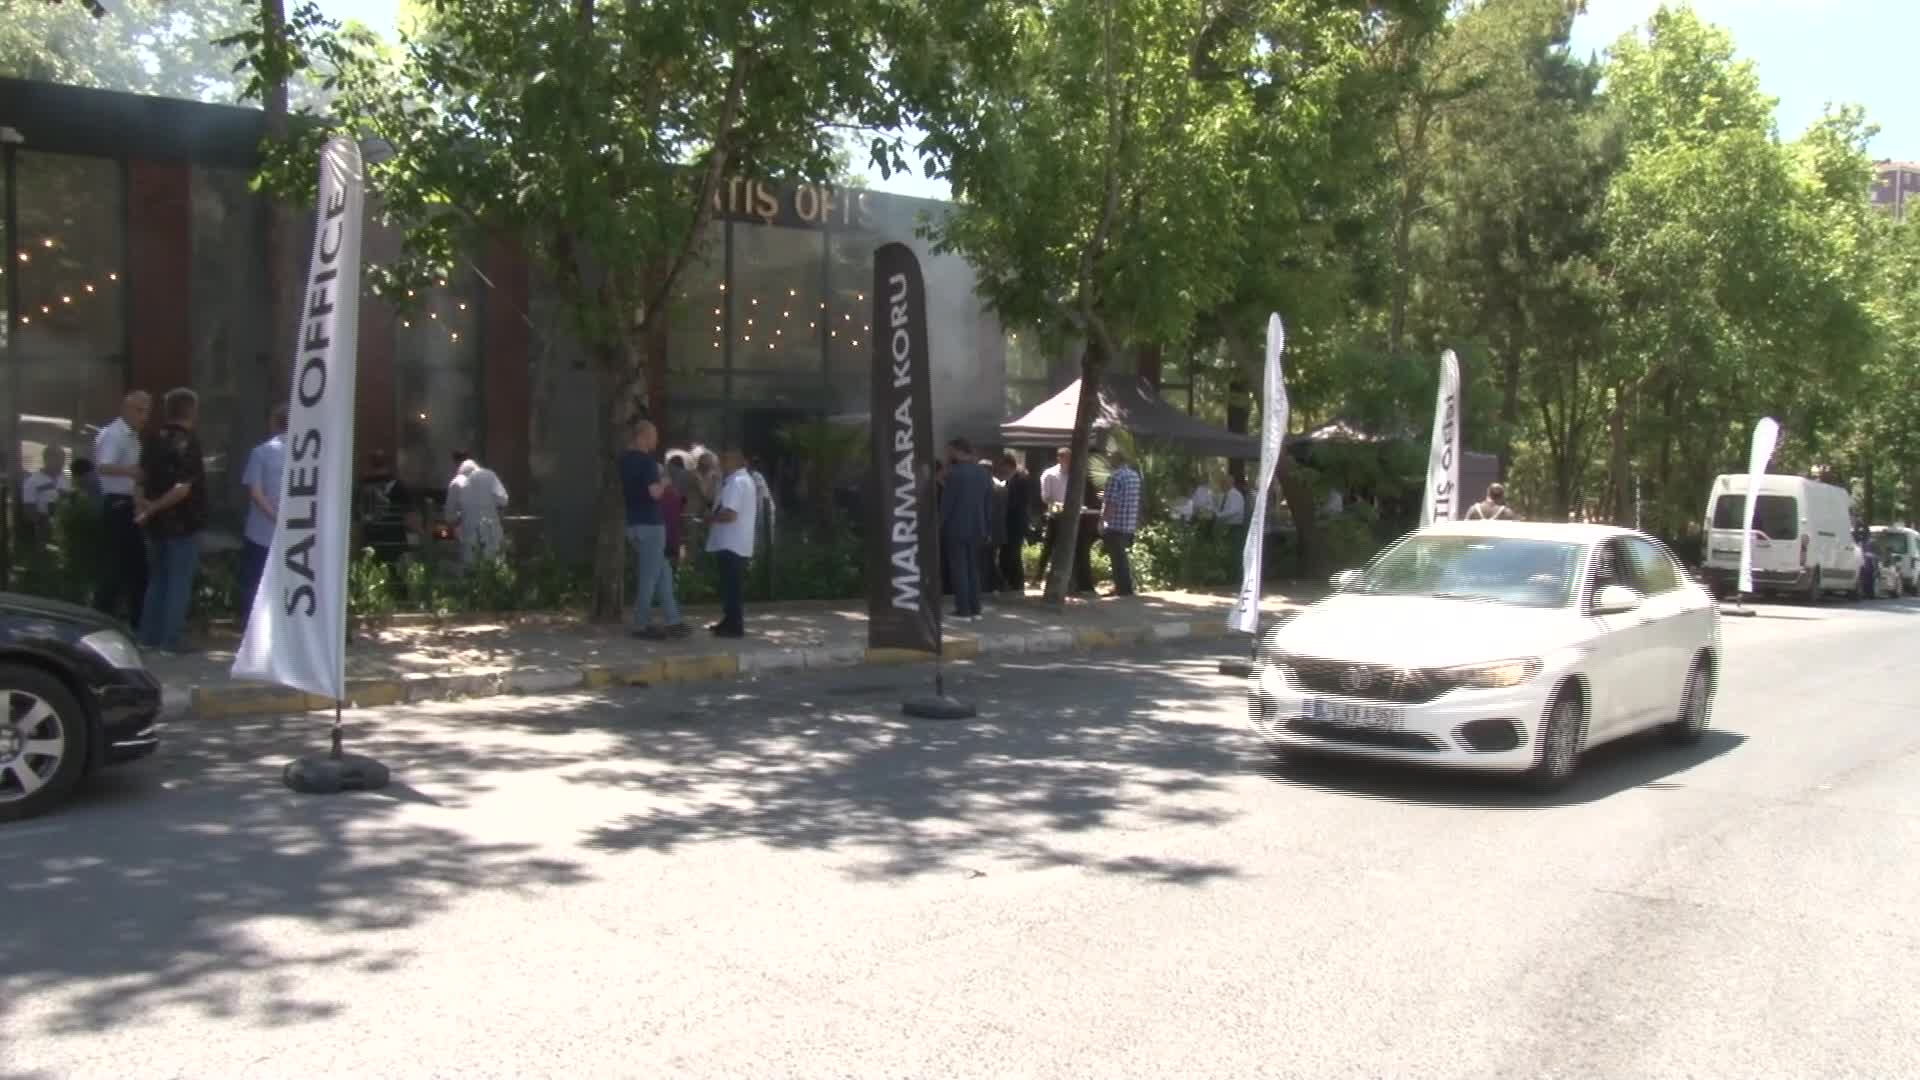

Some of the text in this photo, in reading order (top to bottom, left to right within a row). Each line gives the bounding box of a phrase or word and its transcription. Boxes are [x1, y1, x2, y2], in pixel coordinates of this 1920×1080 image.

[713, 176, 779, 225] TIŞ
[284, 184, 348, 617] SALES OFFICE
[888, 272, 921, 612] MARMARA KORU
